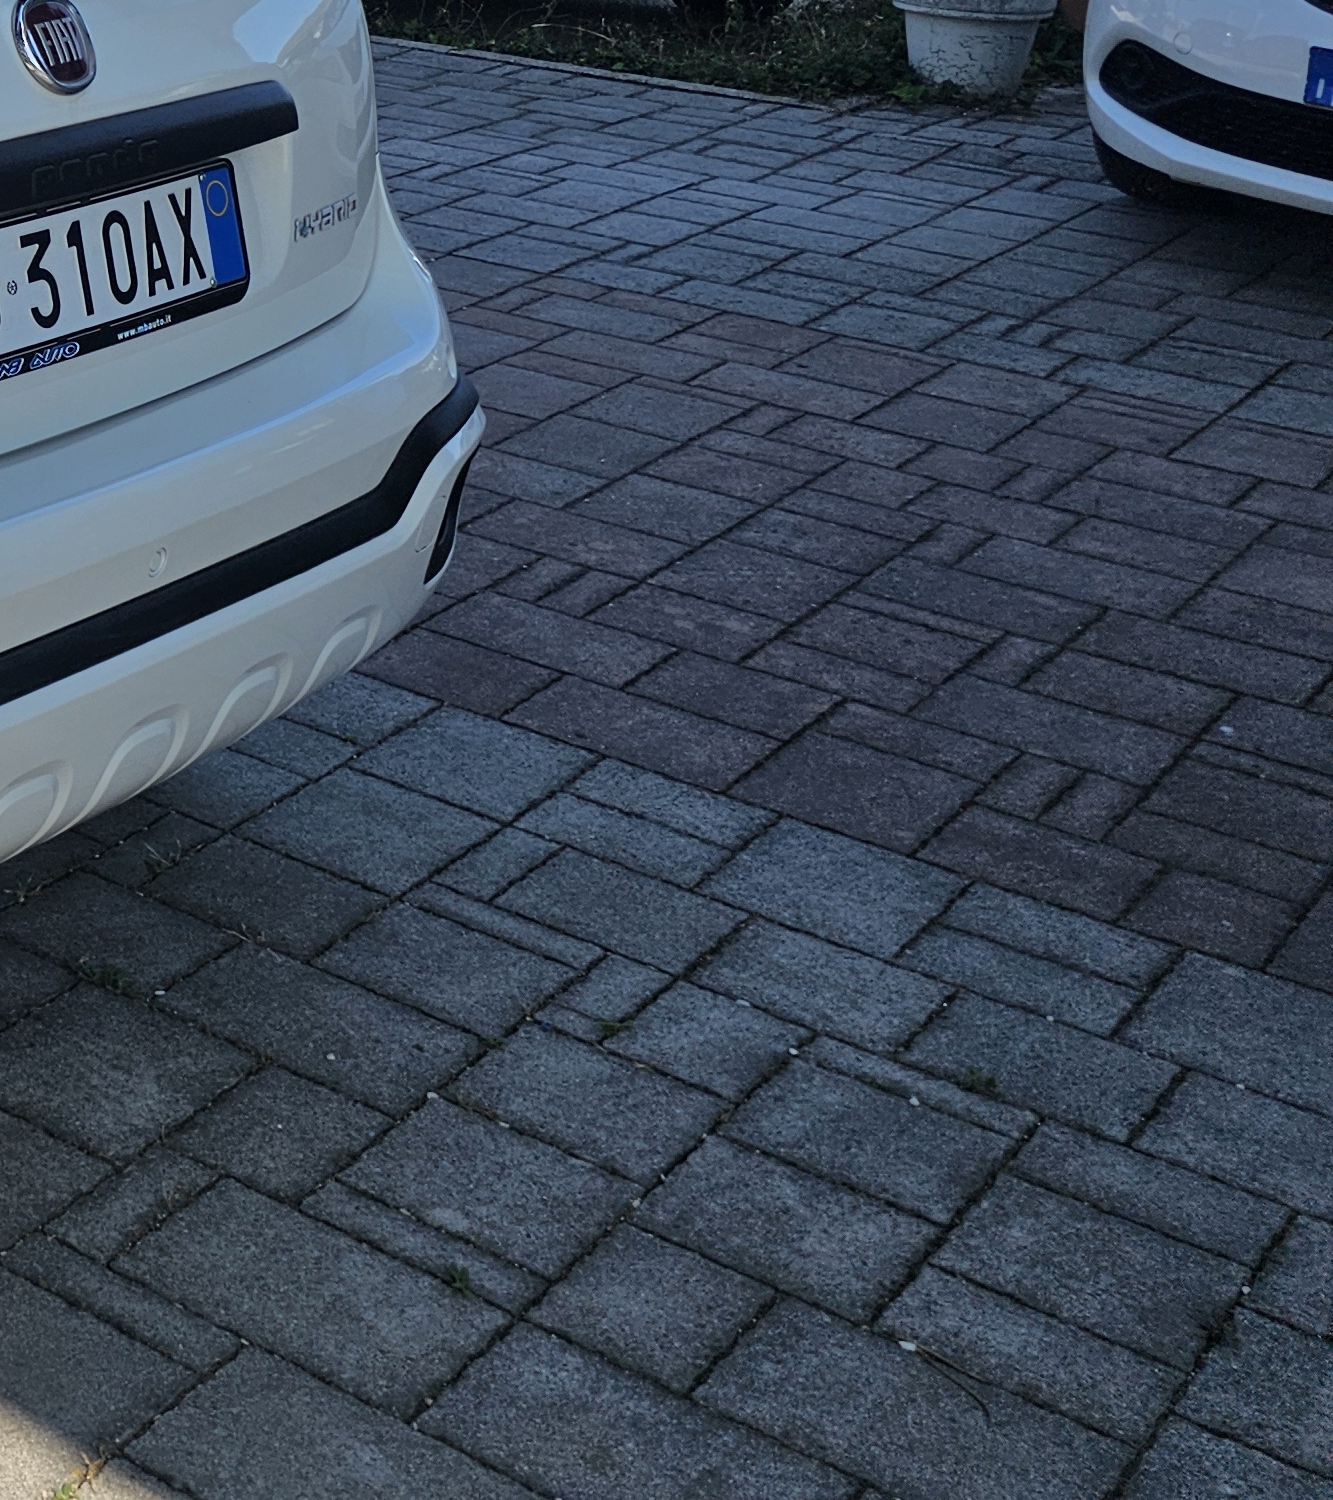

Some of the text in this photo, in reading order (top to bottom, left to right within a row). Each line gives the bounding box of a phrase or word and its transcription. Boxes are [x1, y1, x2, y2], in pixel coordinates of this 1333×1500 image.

[34, 17, 83, 67] FIAT
[19, 186, 207, 329] 310AX
[116, 314, 172, 341] www.mbauto.it
[29, 341, 80, 370] AUTO
